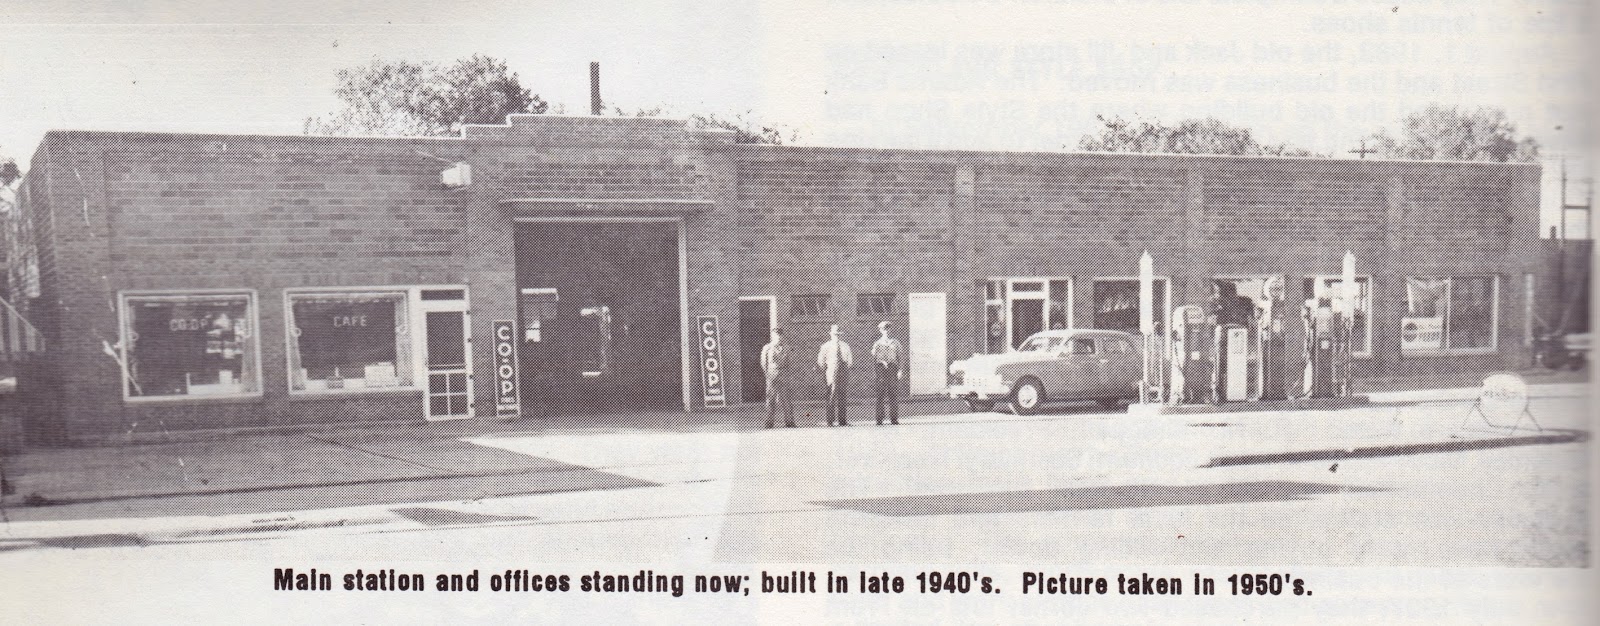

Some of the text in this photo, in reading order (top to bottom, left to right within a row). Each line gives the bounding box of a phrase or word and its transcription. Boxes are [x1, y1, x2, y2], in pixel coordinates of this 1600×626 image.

[333, 314, 368, 328] CAFE
[702, 321, 719, 387] CO-OP
[497, 325, 514, 395] CO-OP
